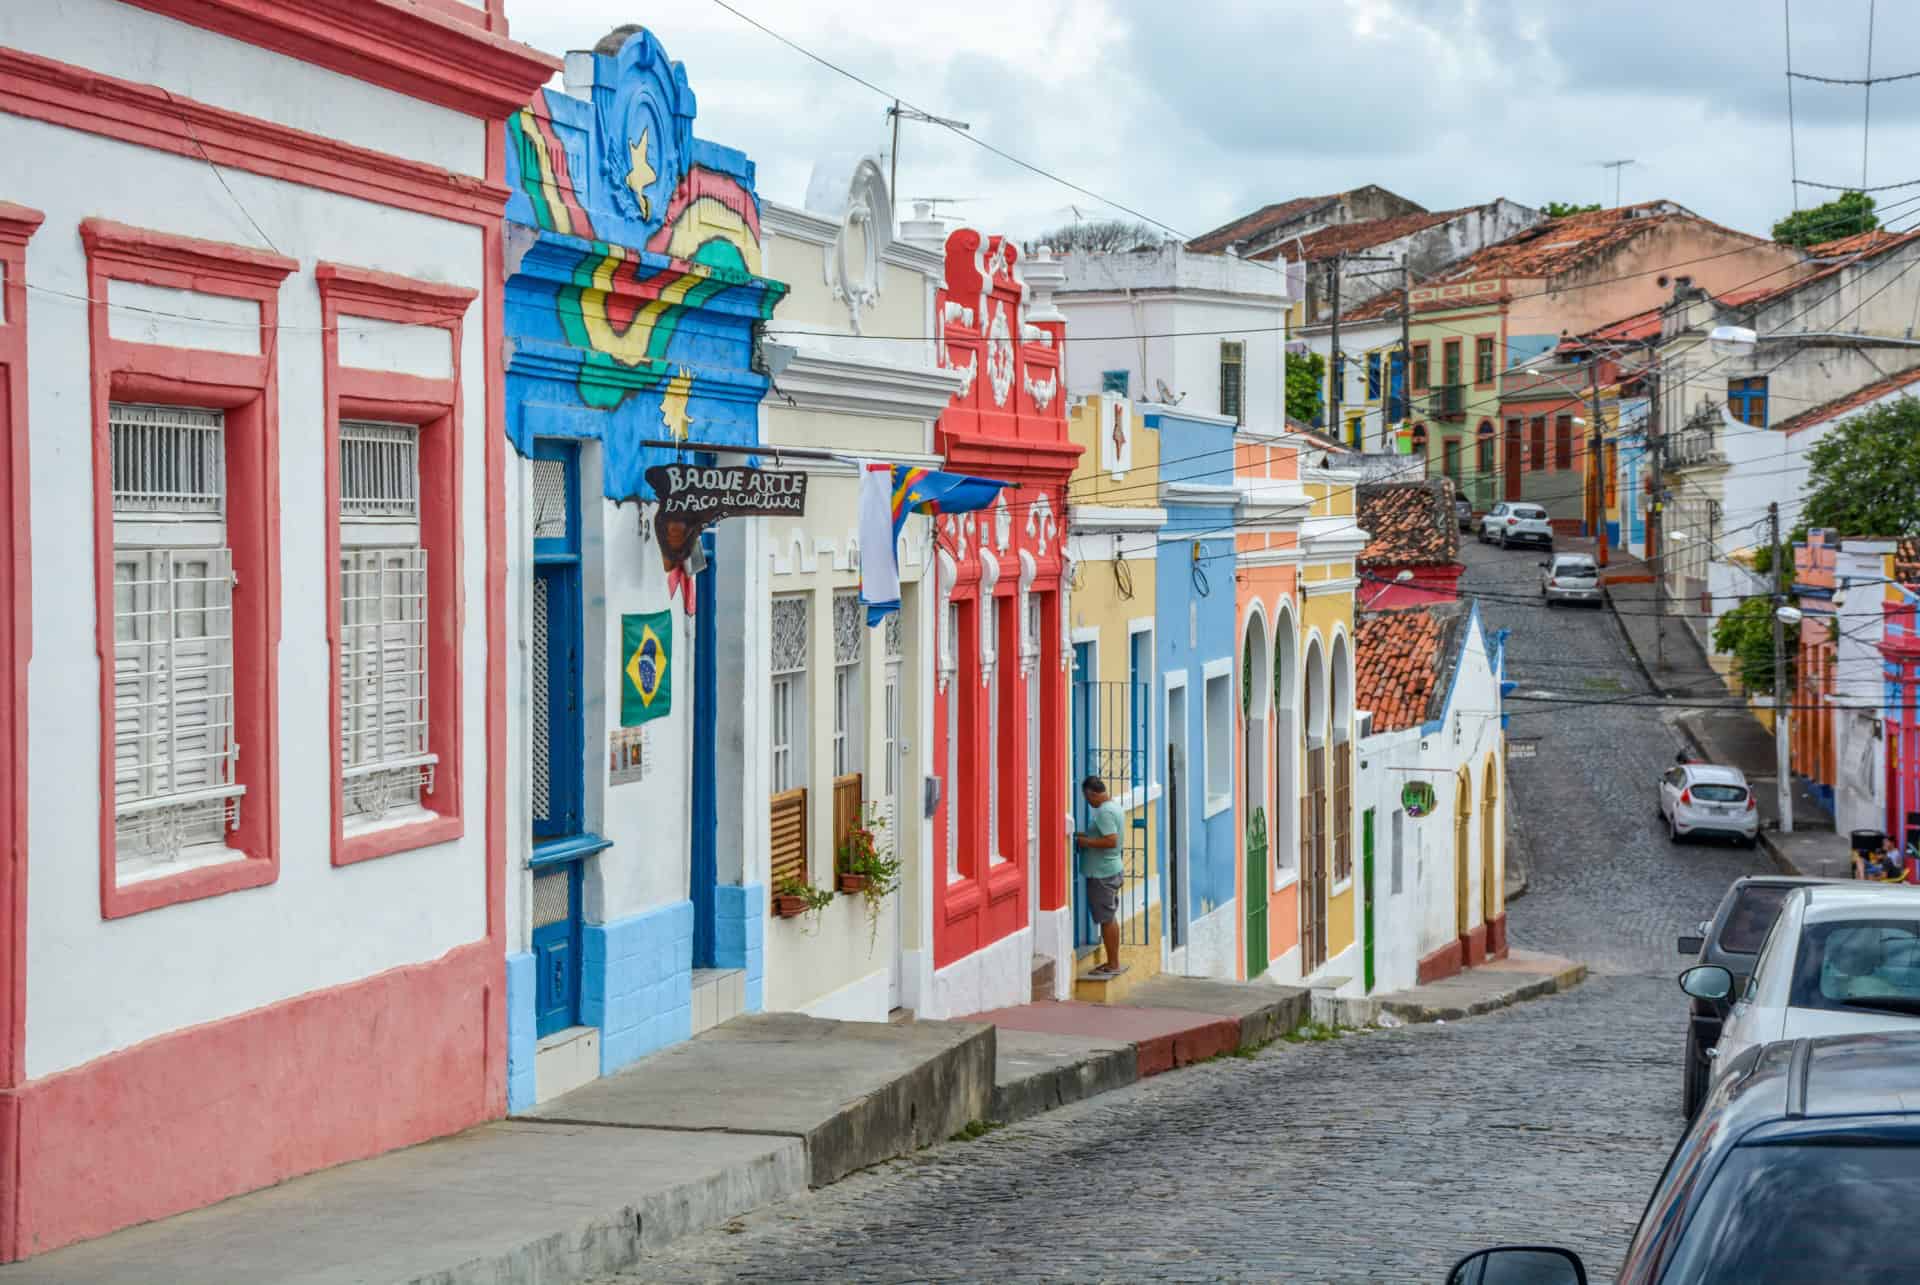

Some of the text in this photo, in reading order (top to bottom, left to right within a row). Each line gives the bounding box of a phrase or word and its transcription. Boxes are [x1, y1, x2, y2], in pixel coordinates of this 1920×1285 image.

[665, 467, 803, 495] BAQUE ARTE
[721, 490, 736, 506] de
